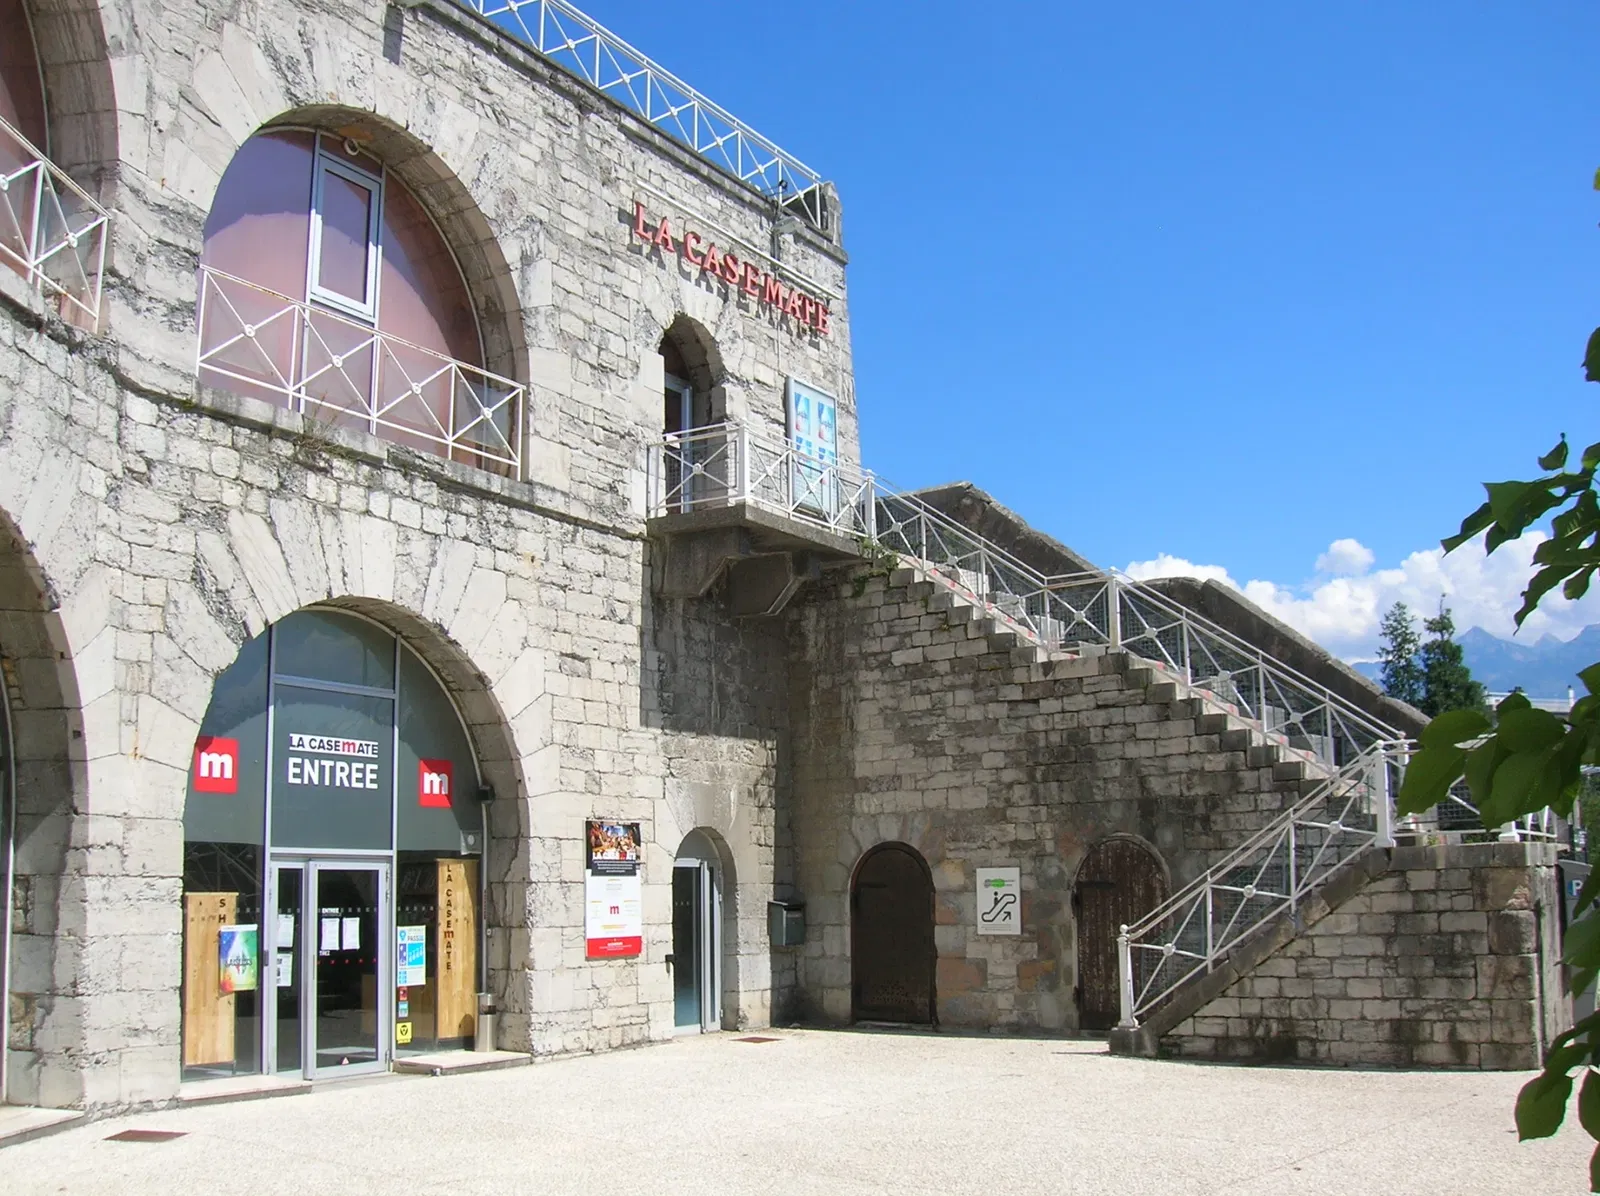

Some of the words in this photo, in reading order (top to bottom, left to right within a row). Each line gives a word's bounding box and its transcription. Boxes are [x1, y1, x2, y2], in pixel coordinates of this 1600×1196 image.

[634, 201, 675, 253] LA
[684, 230, 830, 335] CASEMATE
[290, 736, 305, 749] LA
[200, 752, 232, 779] m
[288, 757, 378, 789] ENTREE
[424, 772, 449, 795] m
[447, 864, 453, 882] LA
[1572, 880, 1583, 896] P
